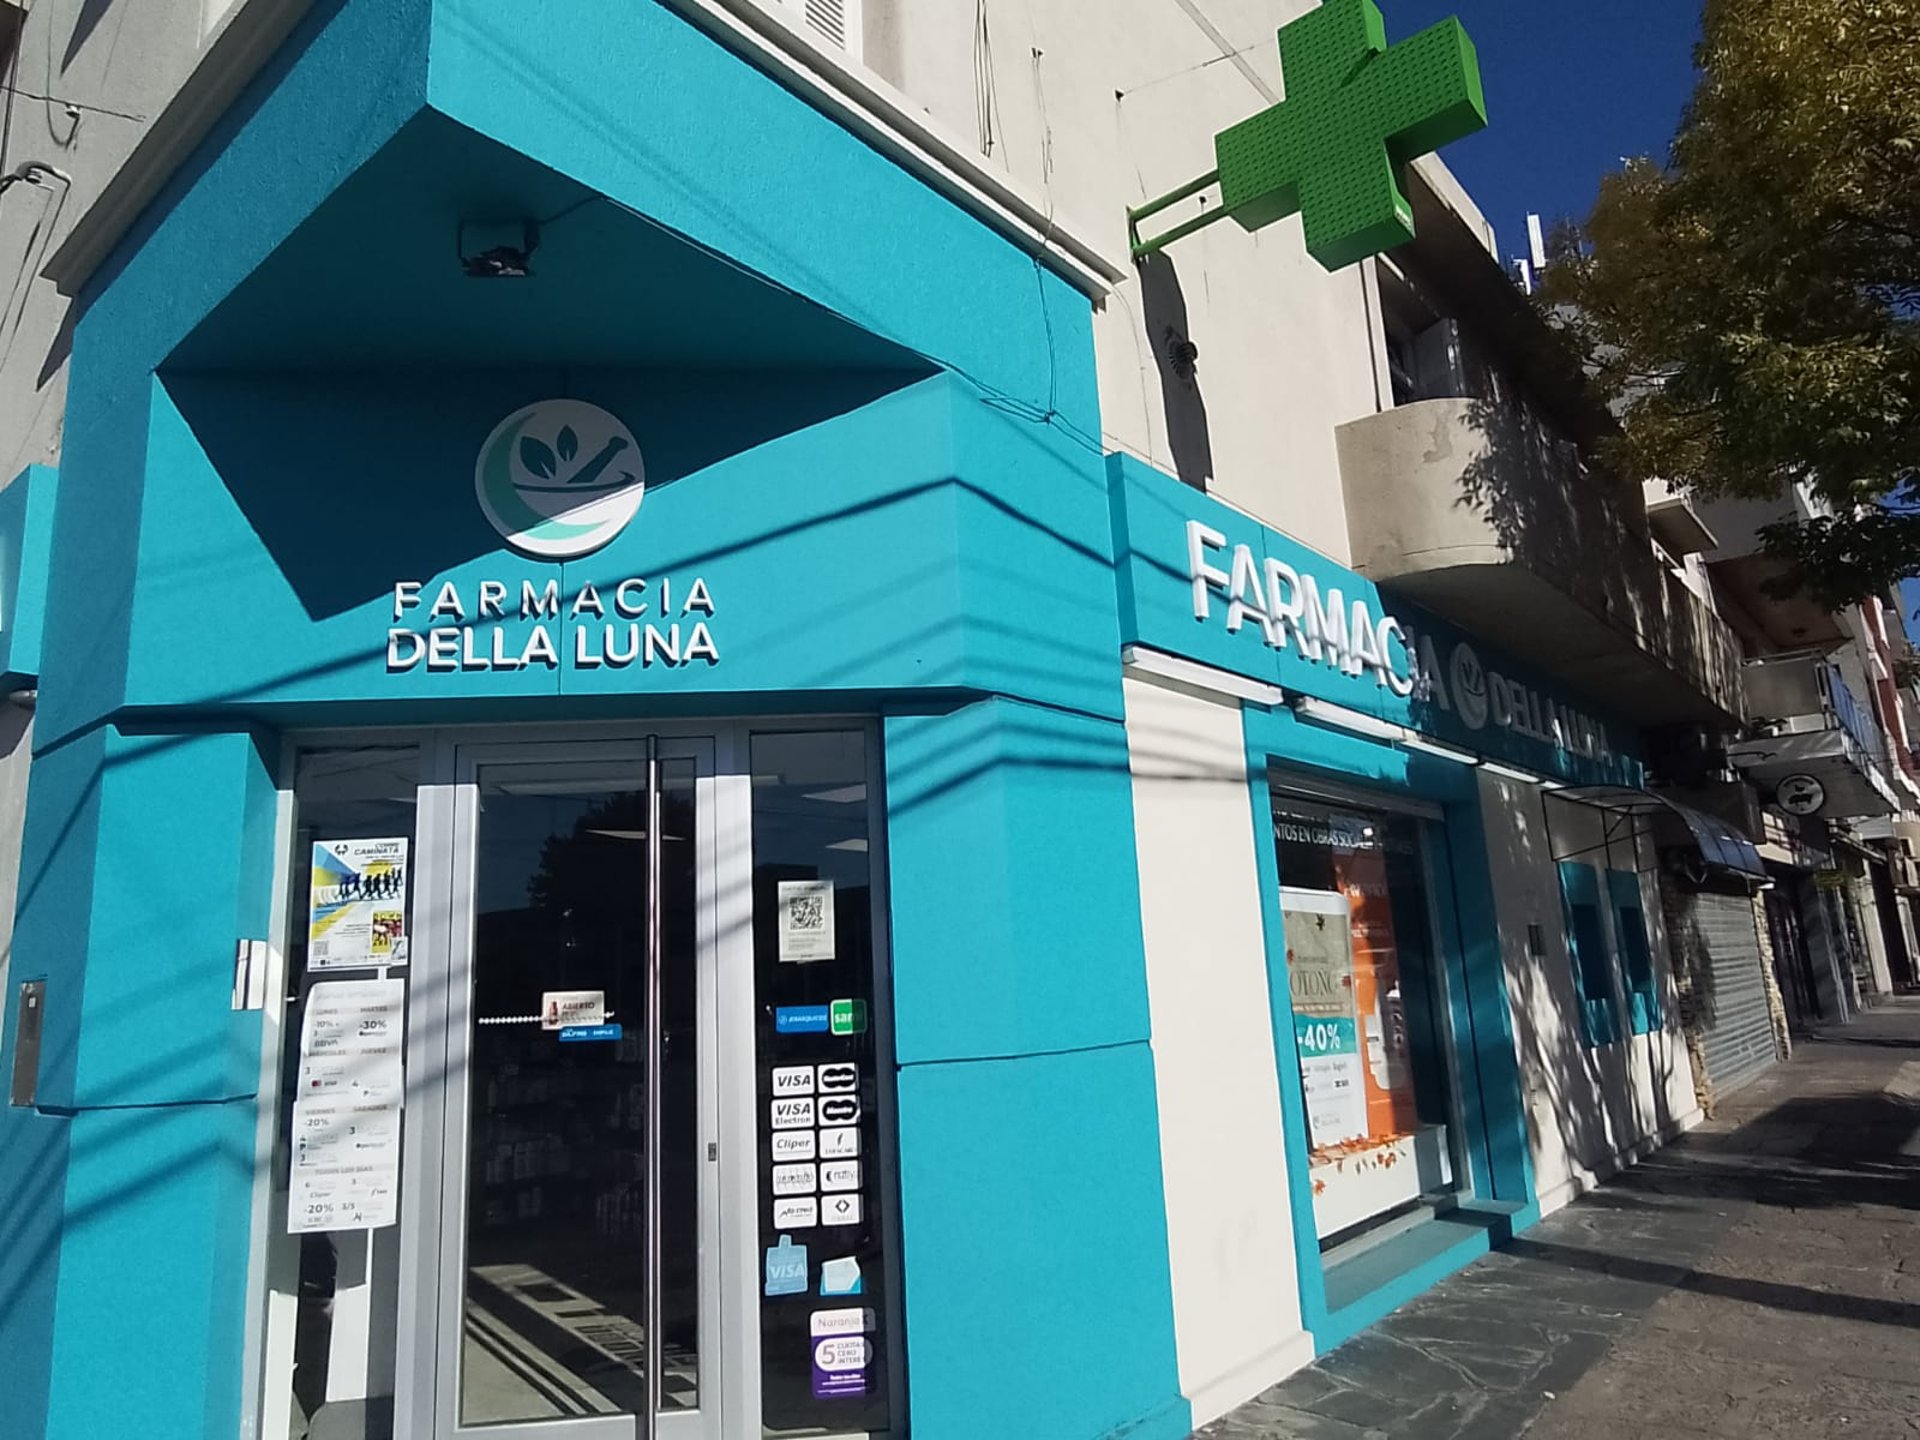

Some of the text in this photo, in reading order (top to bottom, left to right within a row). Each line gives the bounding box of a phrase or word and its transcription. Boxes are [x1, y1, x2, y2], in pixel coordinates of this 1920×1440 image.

[394, 577, 715, 621] FARMACIA
[1186, 520, 1452, 712] FARMACIA
[386, 622, 719, 673] DELLA LUNA
[1487, 671, 1613, 765] DELLA LUNA
[1297, 1023, 1341, 1051] -40%
[777, 1075, 811, 1087] VISA
[777, 1104, 811, 1116] VISA
[775, 1117, 811, 1125] Electron
[776, 1138, 811, 1150] Cliper
[770, 1264, 805, 1279] VISA
[818, 1316, 860, 1328] Naranja
[822, 1344, 835, 1365] 5
